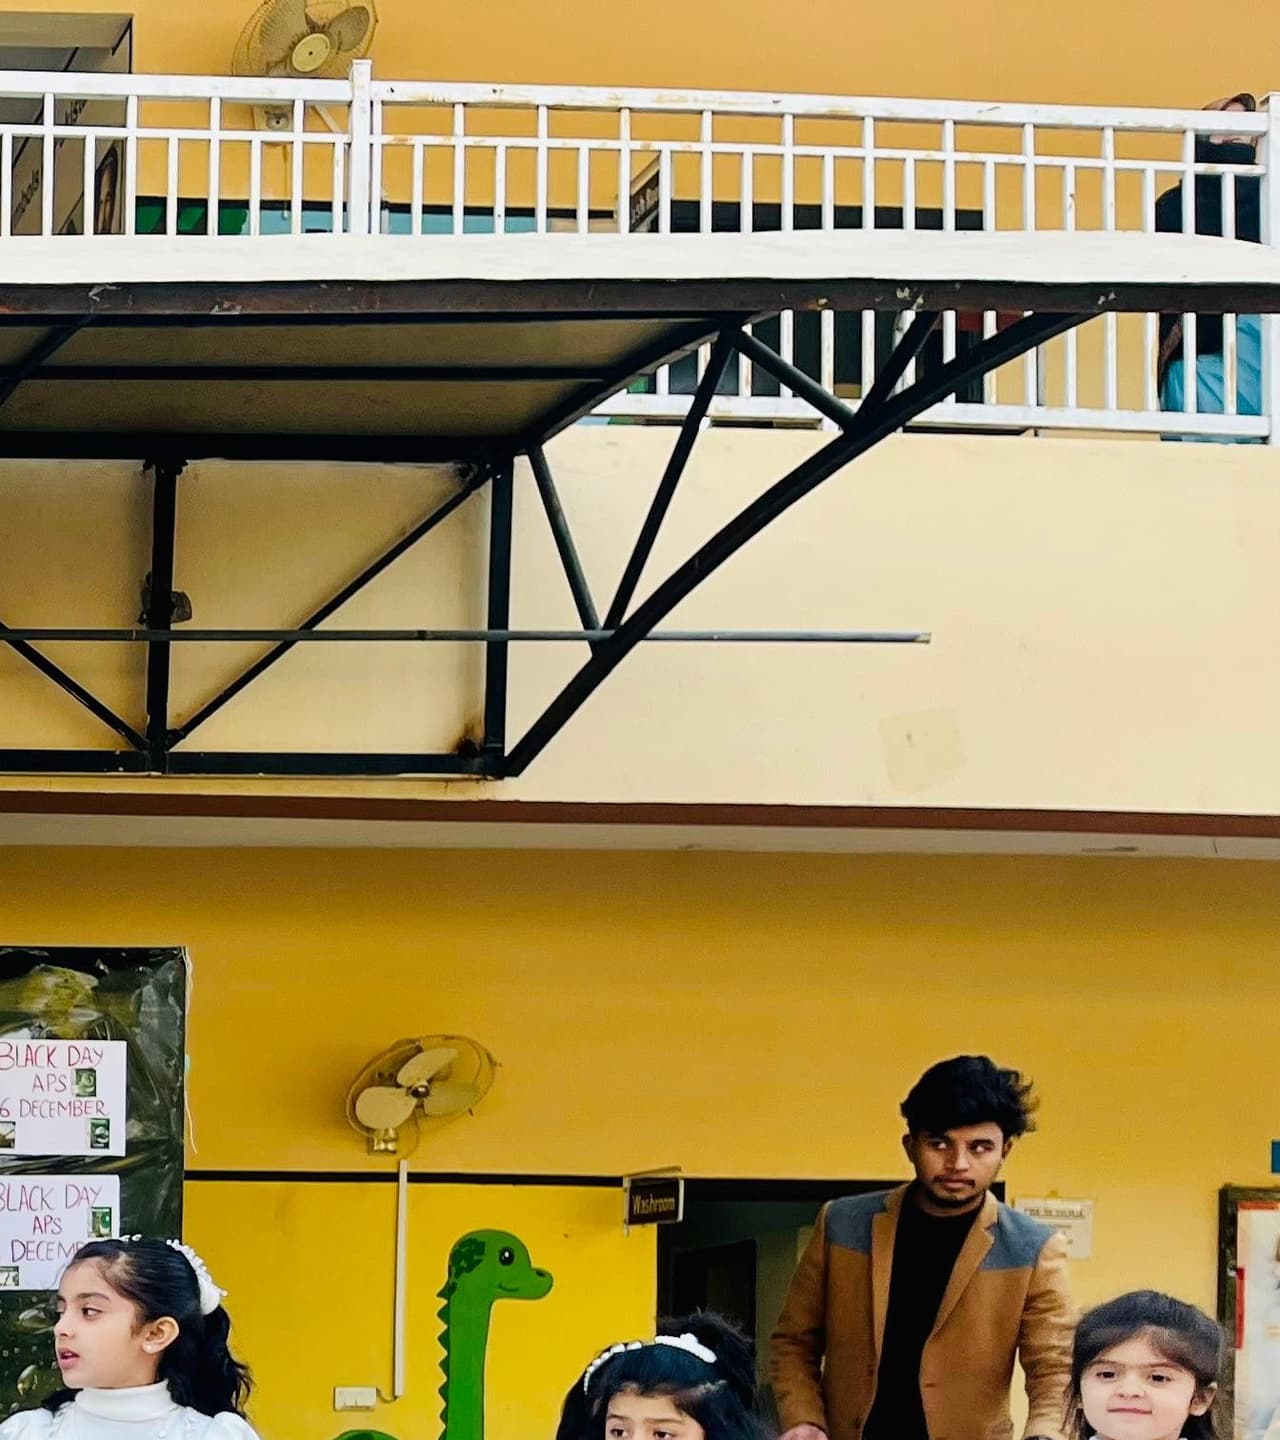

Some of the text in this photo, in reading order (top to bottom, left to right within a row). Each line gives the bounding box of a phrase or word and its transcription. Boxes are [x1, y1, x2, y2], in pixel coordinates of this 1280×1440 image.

[67, 1045, 104, 1068] DAY
[32, 1073, 67, 1093] APS
[19, 1098, 109, 1119] DECEMBER
[65, 1183, 103, 1209] DAY
[632, 1193, 675, 1216] Washroom
[32, 1214, 63, 1235] APS
